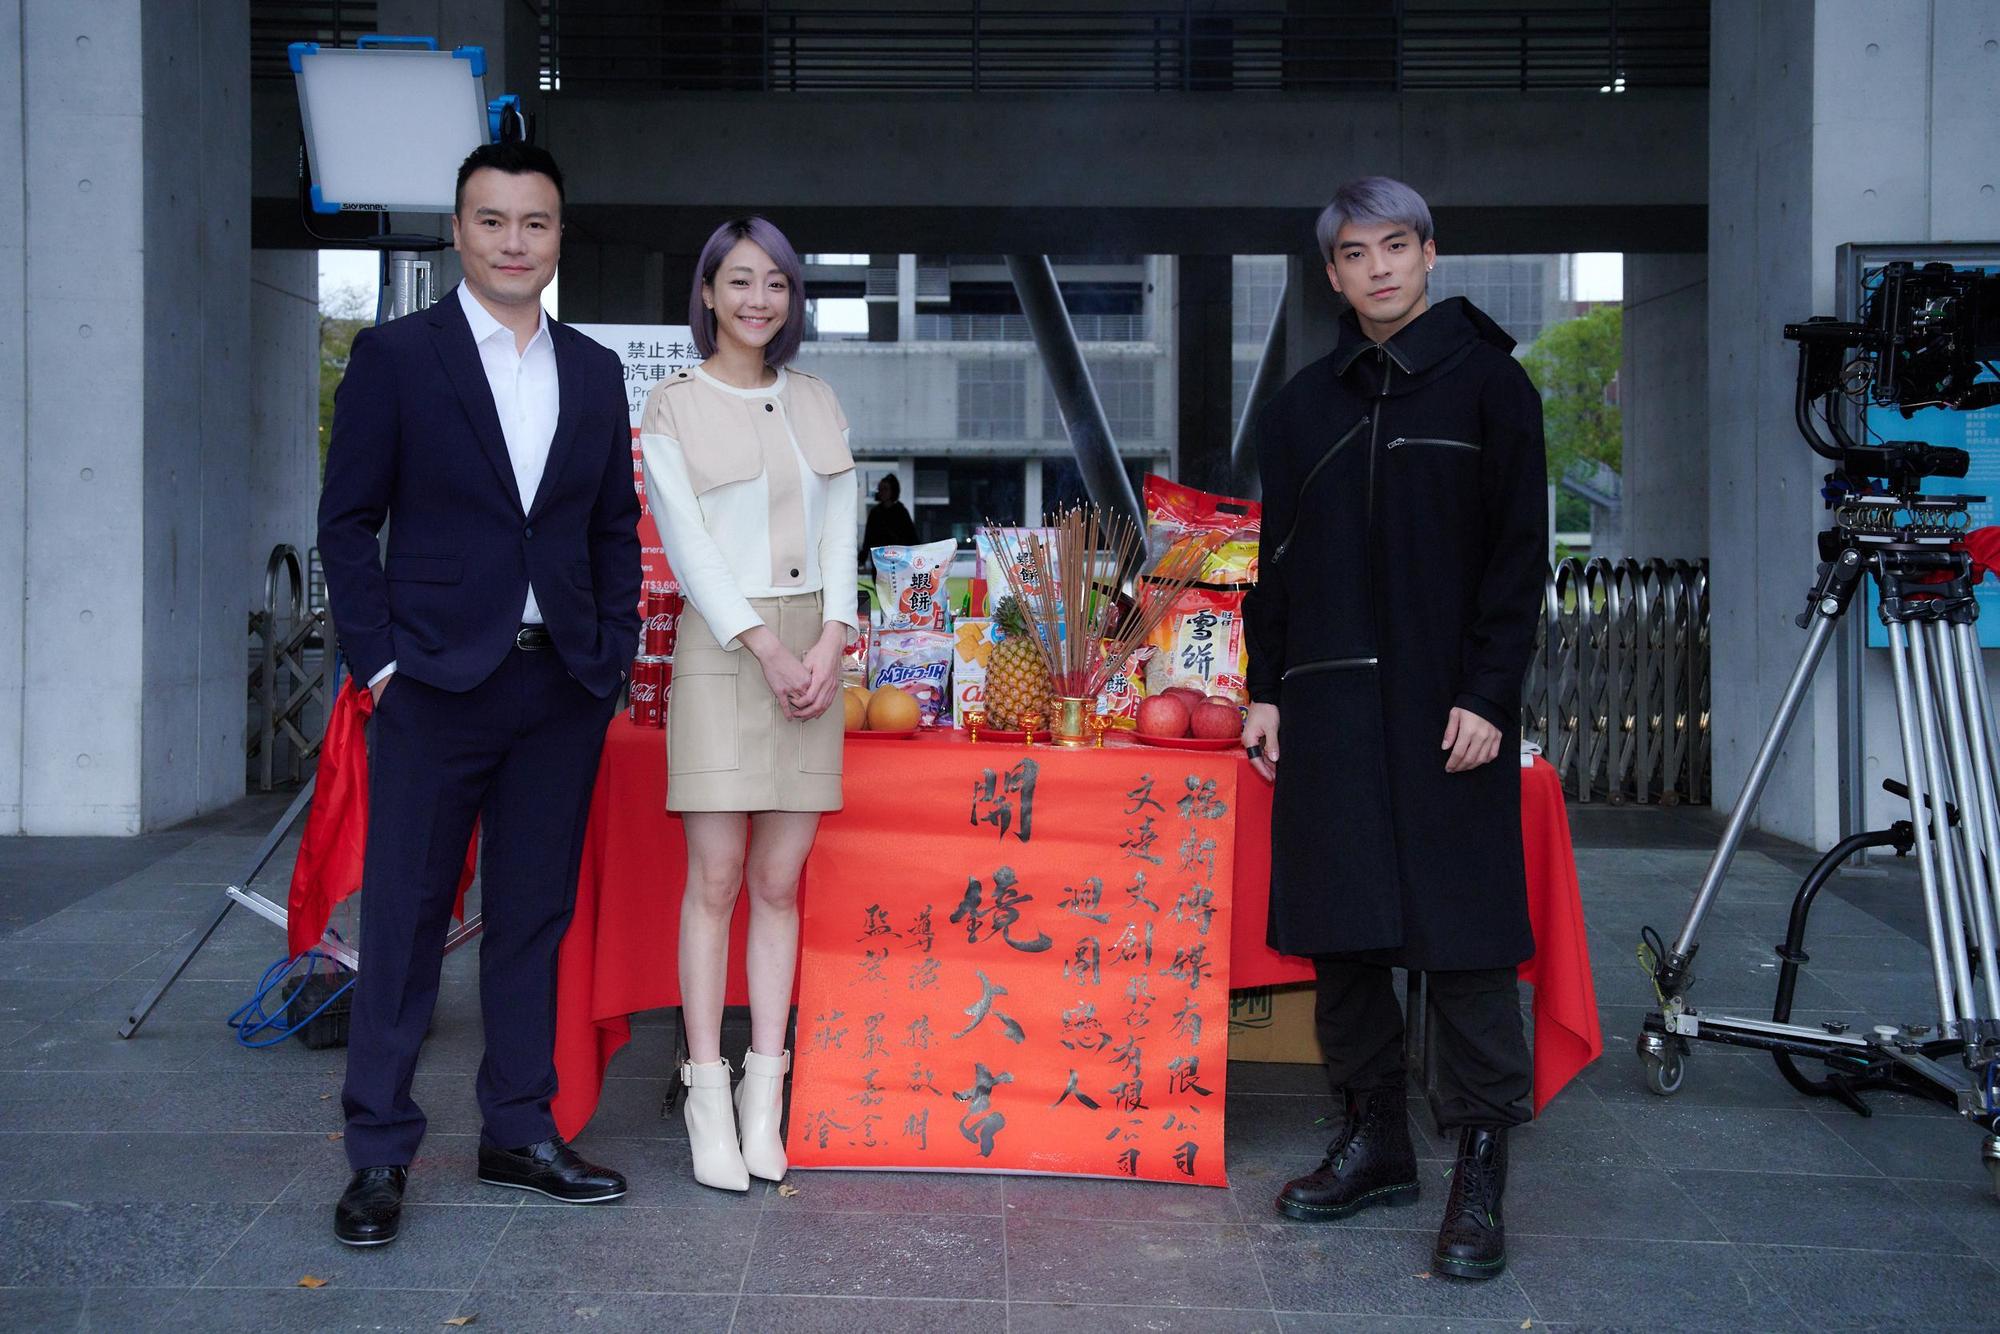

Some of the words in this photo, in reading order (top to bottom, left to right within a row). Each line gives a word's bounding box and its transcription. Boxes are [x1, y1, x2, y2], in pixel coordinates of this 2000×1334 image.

[909, 573, 932, 610] 蝦餅
[1181, 609, 1218, 681] 雪餅
[876, 664, 946, 687] HI-CHEW
